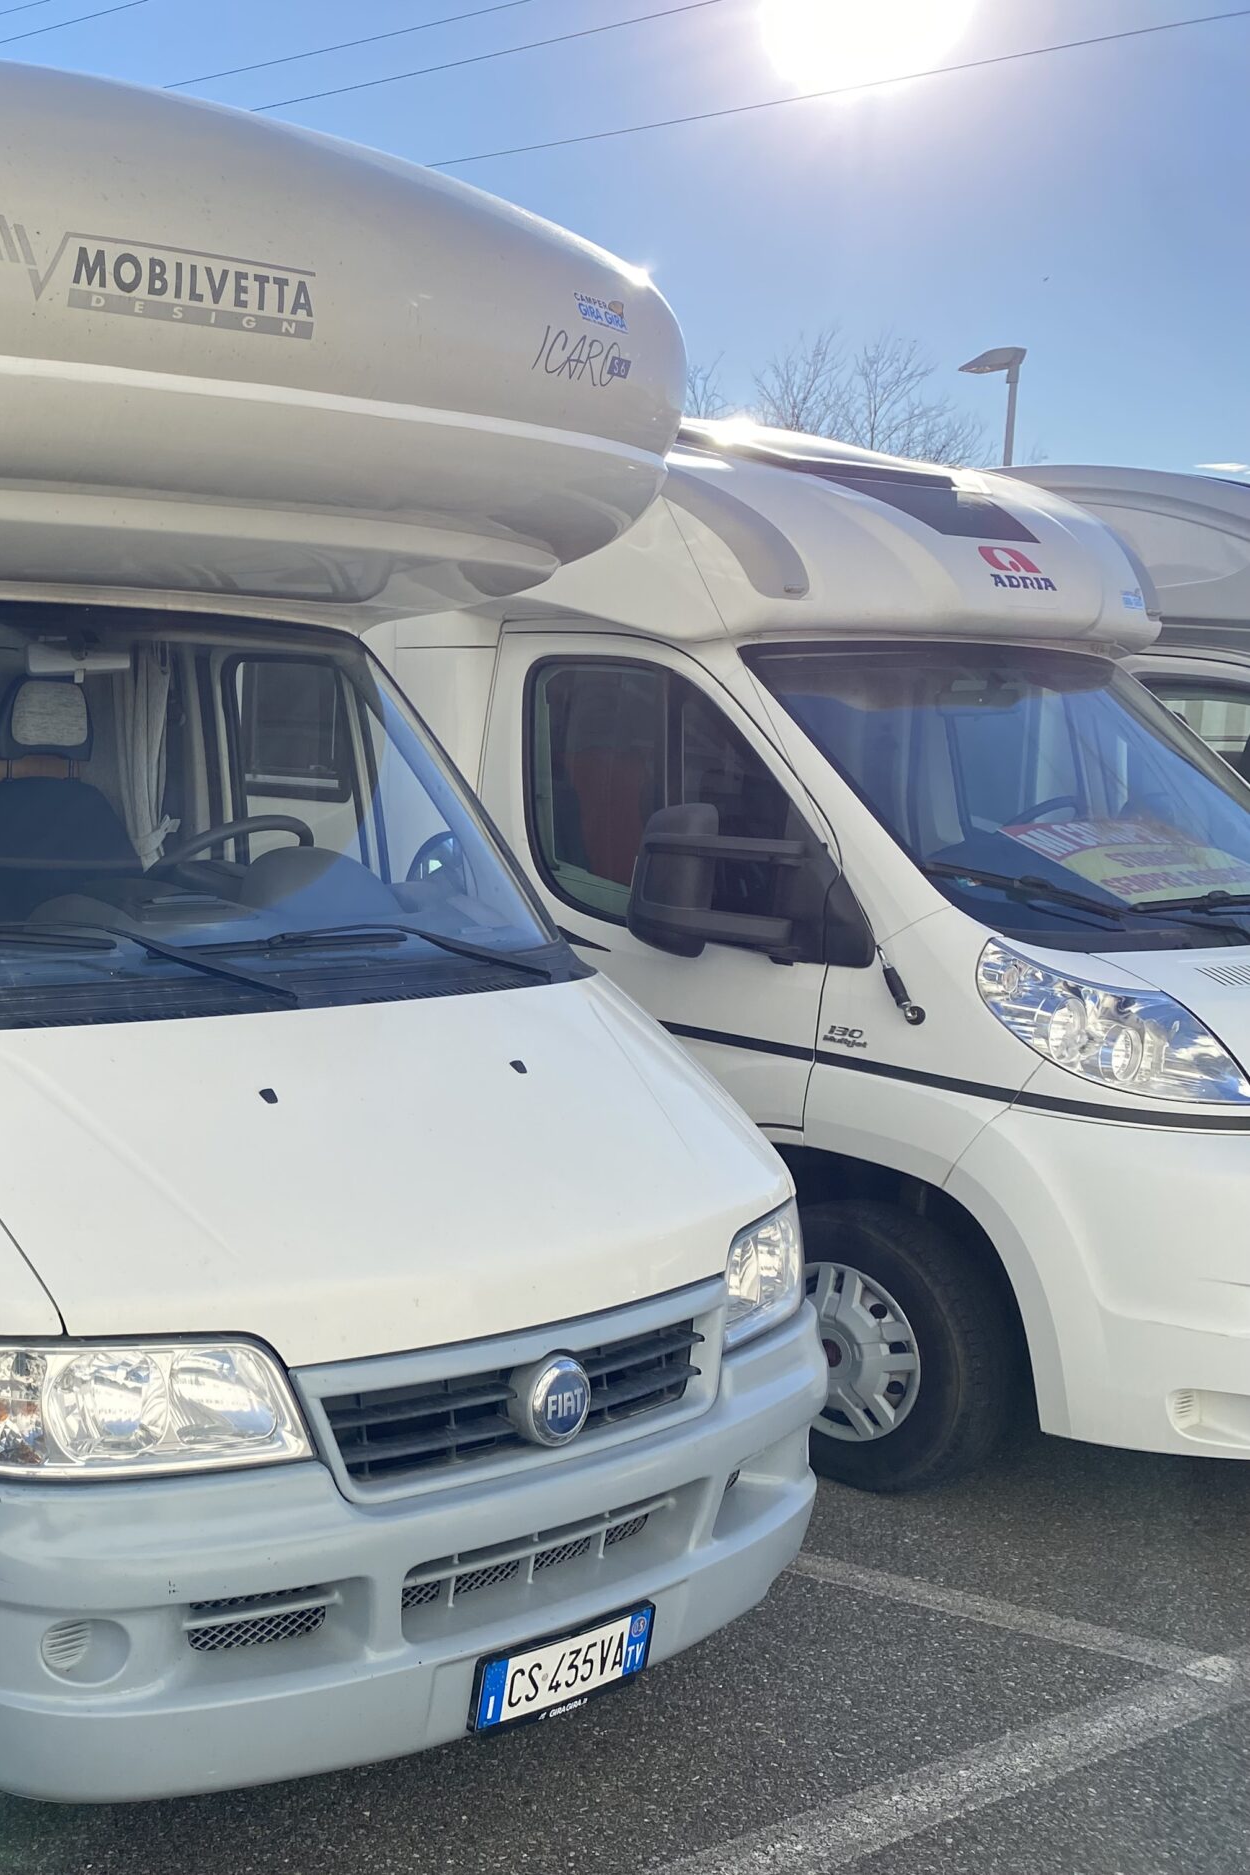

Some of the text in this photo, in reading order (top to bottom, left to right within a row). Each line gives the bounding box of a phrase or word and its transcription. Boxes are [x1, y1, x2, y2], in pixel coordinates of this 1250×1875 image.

[73, 246, 314, 318] MOBILVETTA
[90, 294, 297, 335] DESIGN
[574, 292, 607, 310] CAMPER
[578, 302, 628, 331] GIRA GIRA
[531, 325, 621, 387] ICARO
[990, 574, 1058, 591] ADRIA
[828, 1025, 864, 1039] 130
[547, 1387, 584, 1420] FIAT
[626, 1641, 645, 1669] TV
